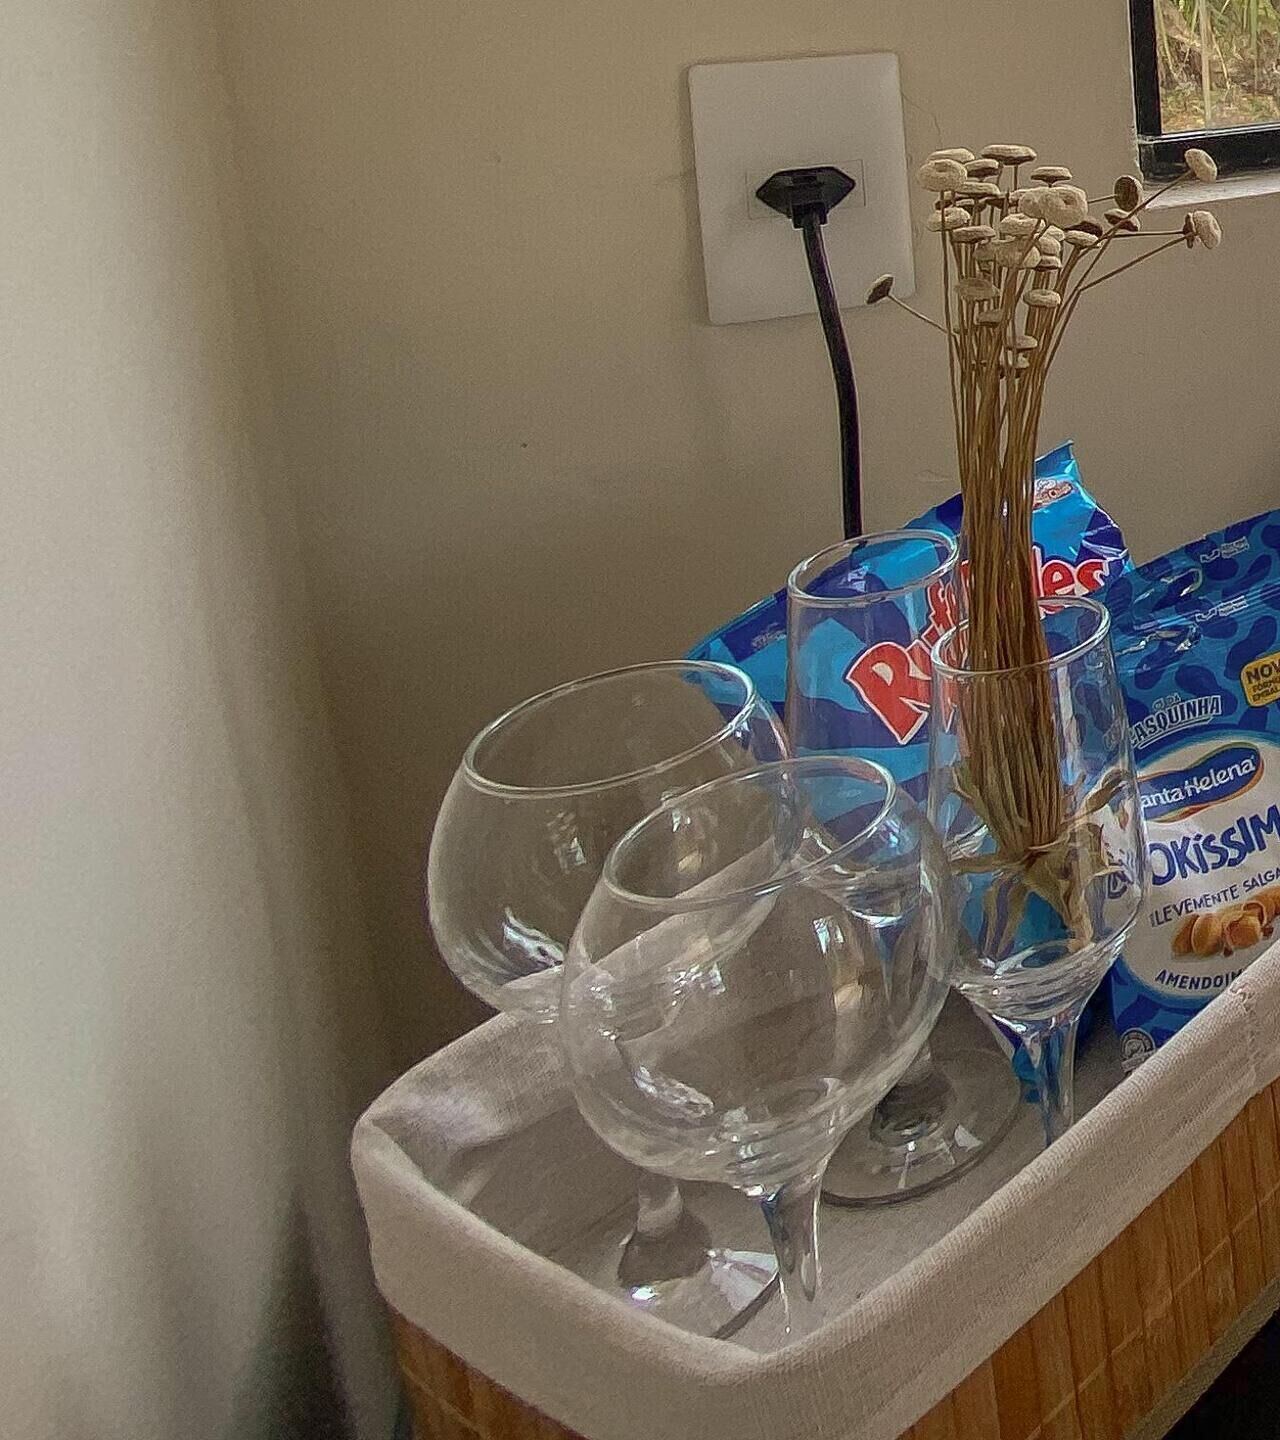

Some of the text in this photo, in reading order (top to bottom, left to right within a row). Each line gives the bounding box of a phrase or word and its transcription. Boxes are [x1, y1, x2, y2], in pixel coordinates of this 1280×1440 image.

[1140, 759, 1256, 810] anta Helena
[1153, 884, 1240, 926] LEVEMENTE
